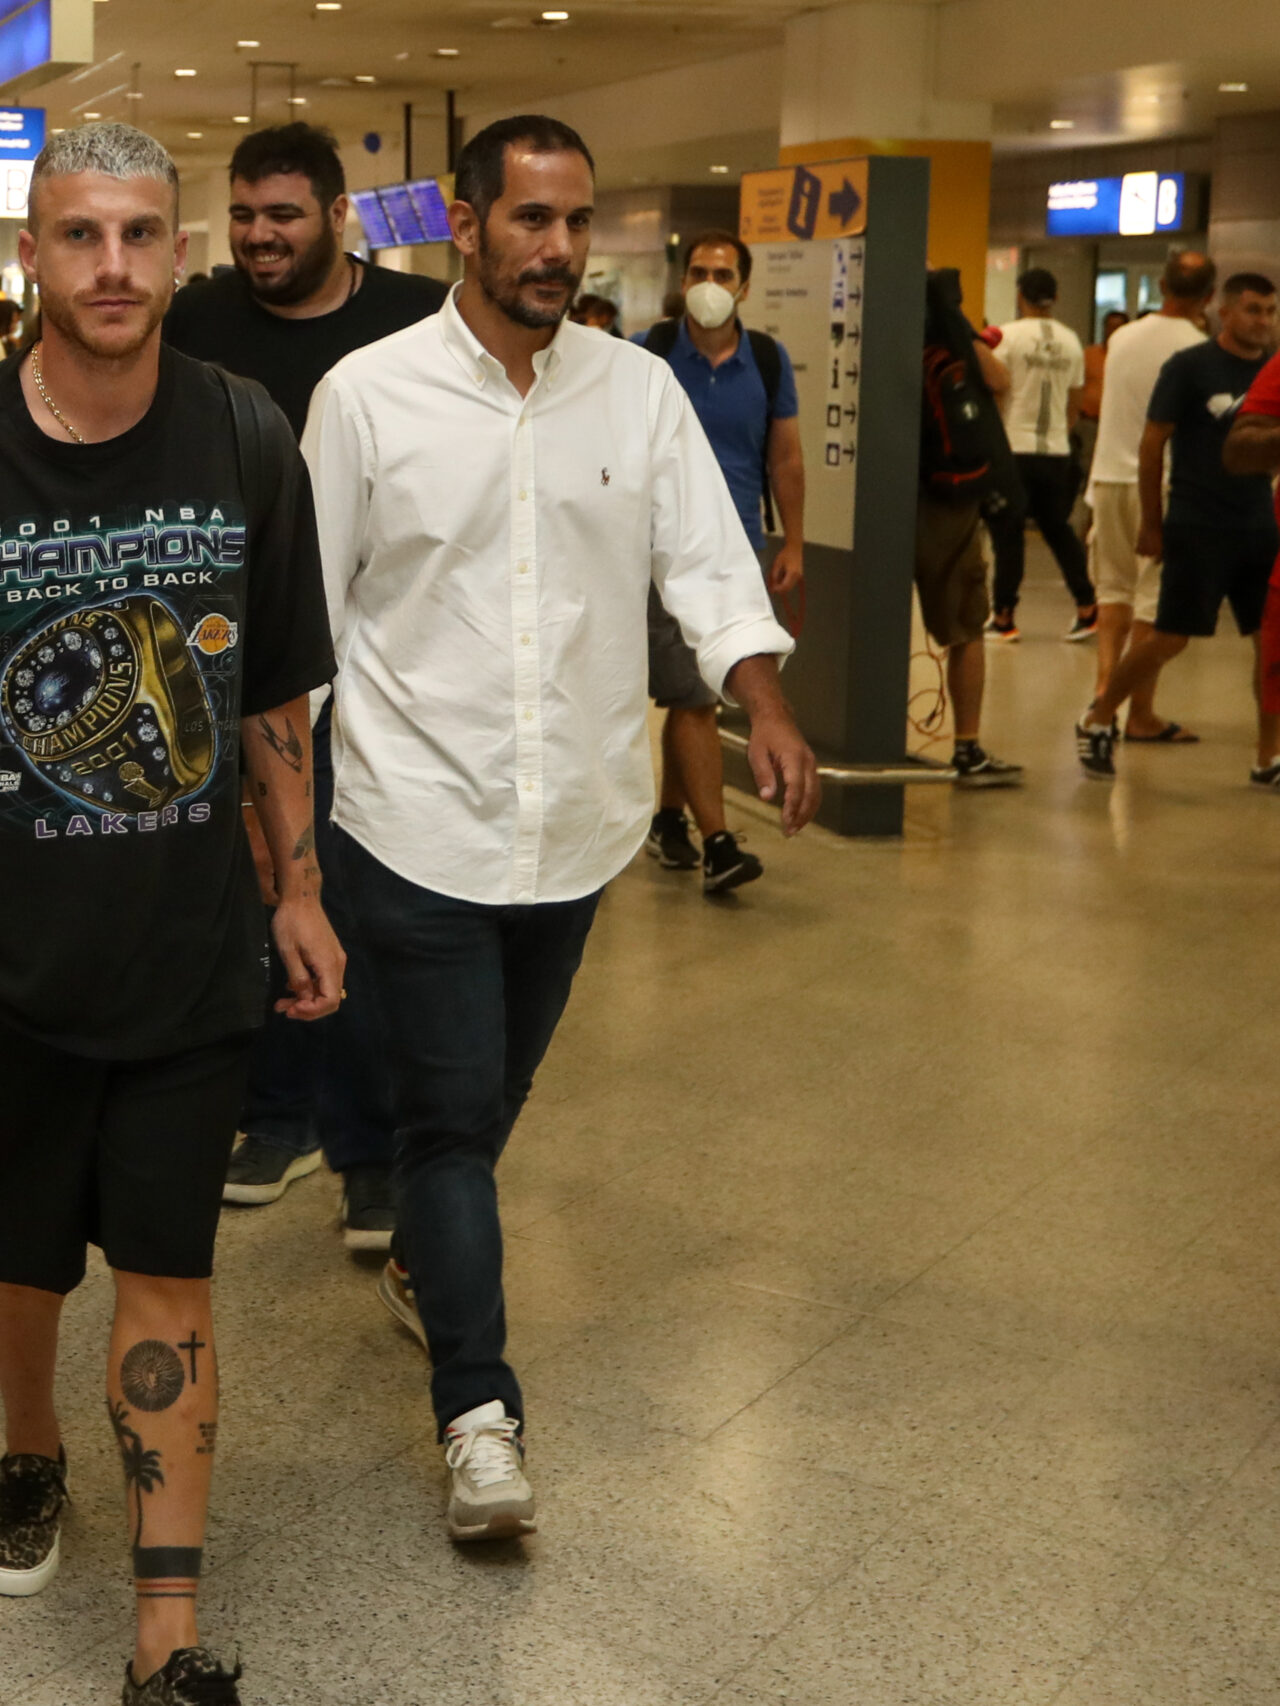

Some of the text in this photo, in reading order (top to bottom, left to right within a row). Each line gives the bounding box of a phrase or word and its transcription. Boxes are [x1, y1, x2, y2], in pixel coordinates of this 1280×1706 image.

[145, 507, 224, 522] NBA
[7, 571, 214, 602] BACK TO BACK
[23, 662, 133, 755] CHAMPIONS
[71, 731, 138, 776] 2001
[35, 803, 210, 839] LAKERS
